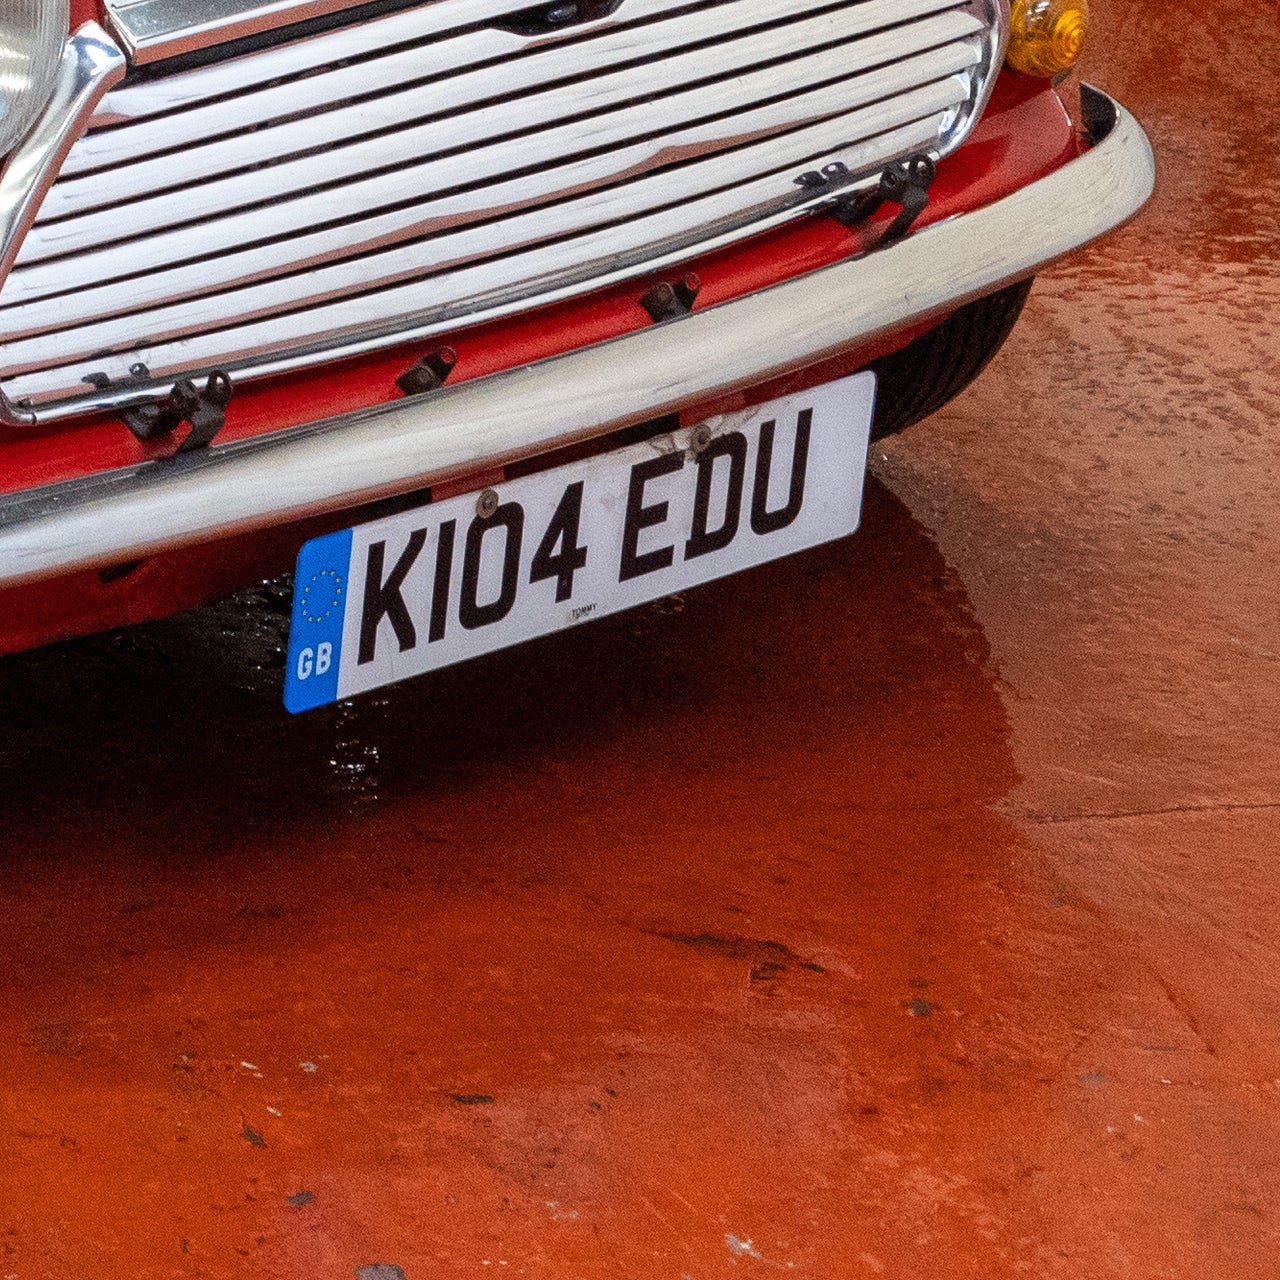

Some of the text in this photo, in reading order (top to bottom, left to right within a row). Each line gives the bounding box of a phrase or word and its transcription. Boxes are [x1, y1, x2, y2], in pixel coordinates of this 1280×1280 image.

[357, 407, 814, 666] K104 EDU
[296, 641, 333, 681] GB
